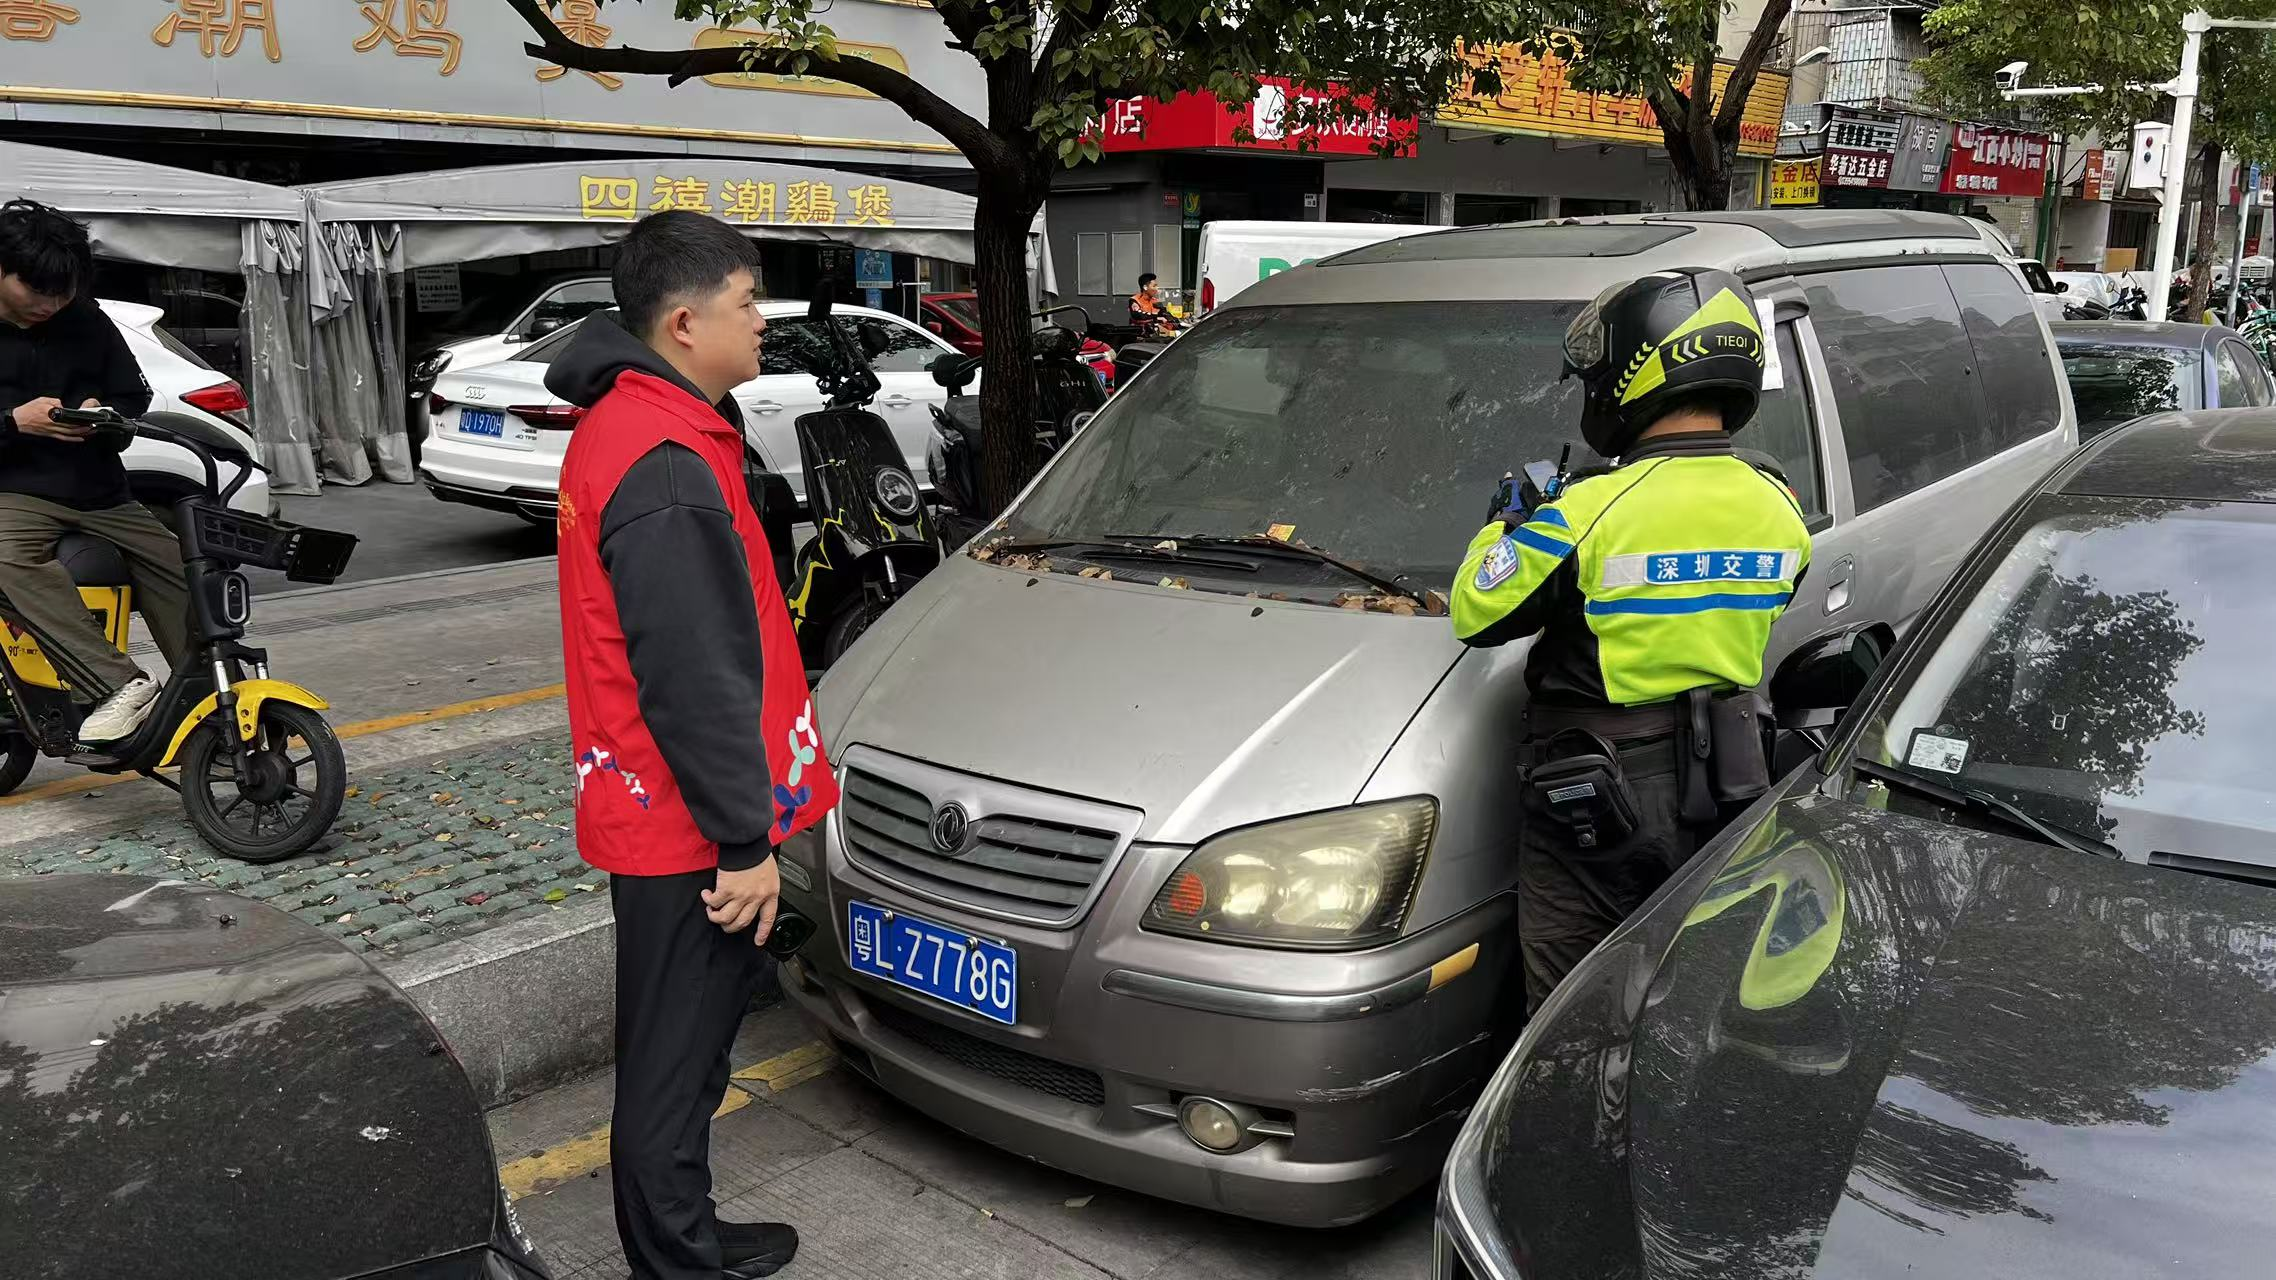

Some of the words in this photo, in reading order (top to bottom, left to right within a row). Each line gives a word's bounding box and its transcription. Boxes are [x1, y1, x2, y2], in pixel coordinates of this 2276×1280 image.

[1972, 134, 2022, 167] 江西小炒
[1829, 154, 1888, 178] 华新达五金店
[1715, 335, 1748, 348] TIEQI
[1657, 554, 1776, 580] 深圳交警
